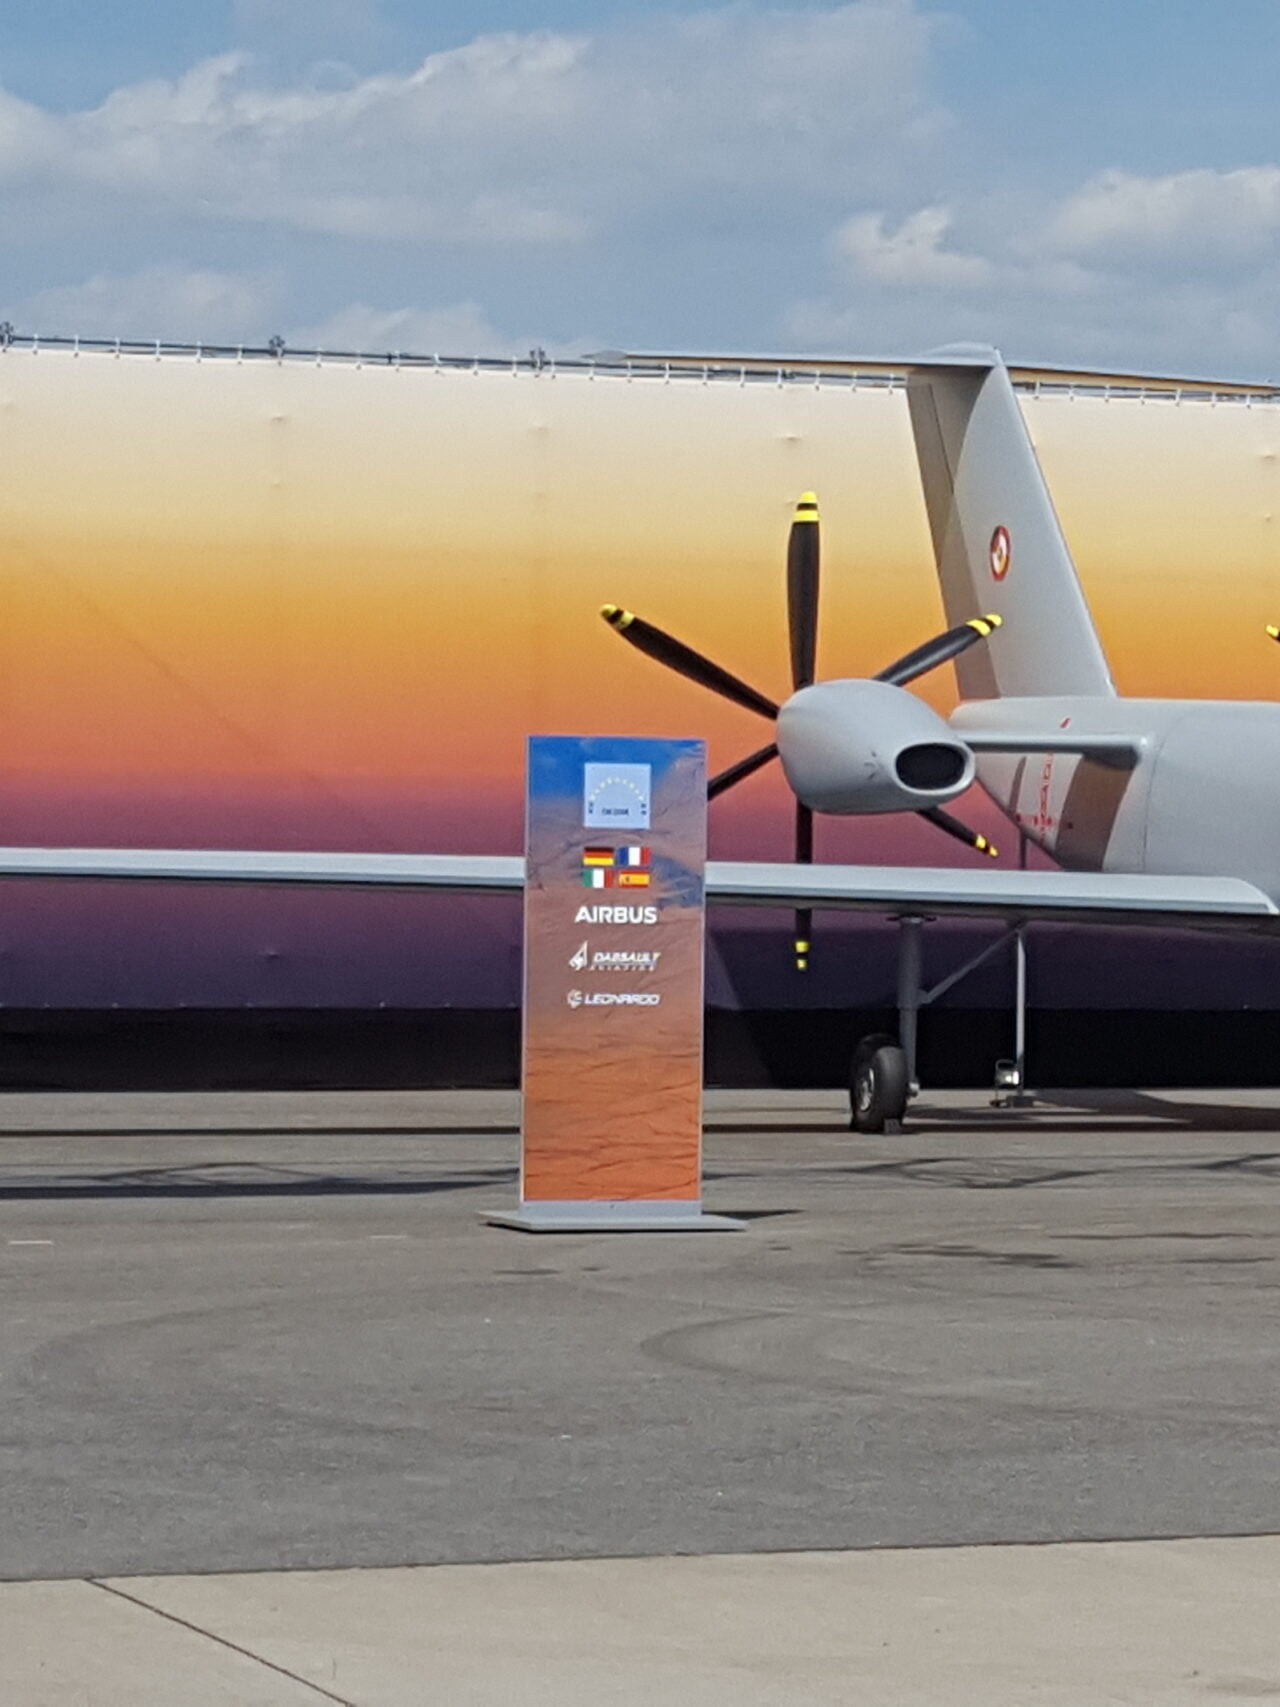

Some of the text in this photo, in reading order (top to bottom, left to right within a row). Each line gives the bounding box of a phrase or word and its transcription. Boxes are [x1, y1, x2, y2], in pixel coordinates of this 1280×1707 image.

[574, 906, 658, 925] AIRBUS
[593, 951, 661, 963] DASSAULT
[584, 993, 661, 1005] LEONARDO
